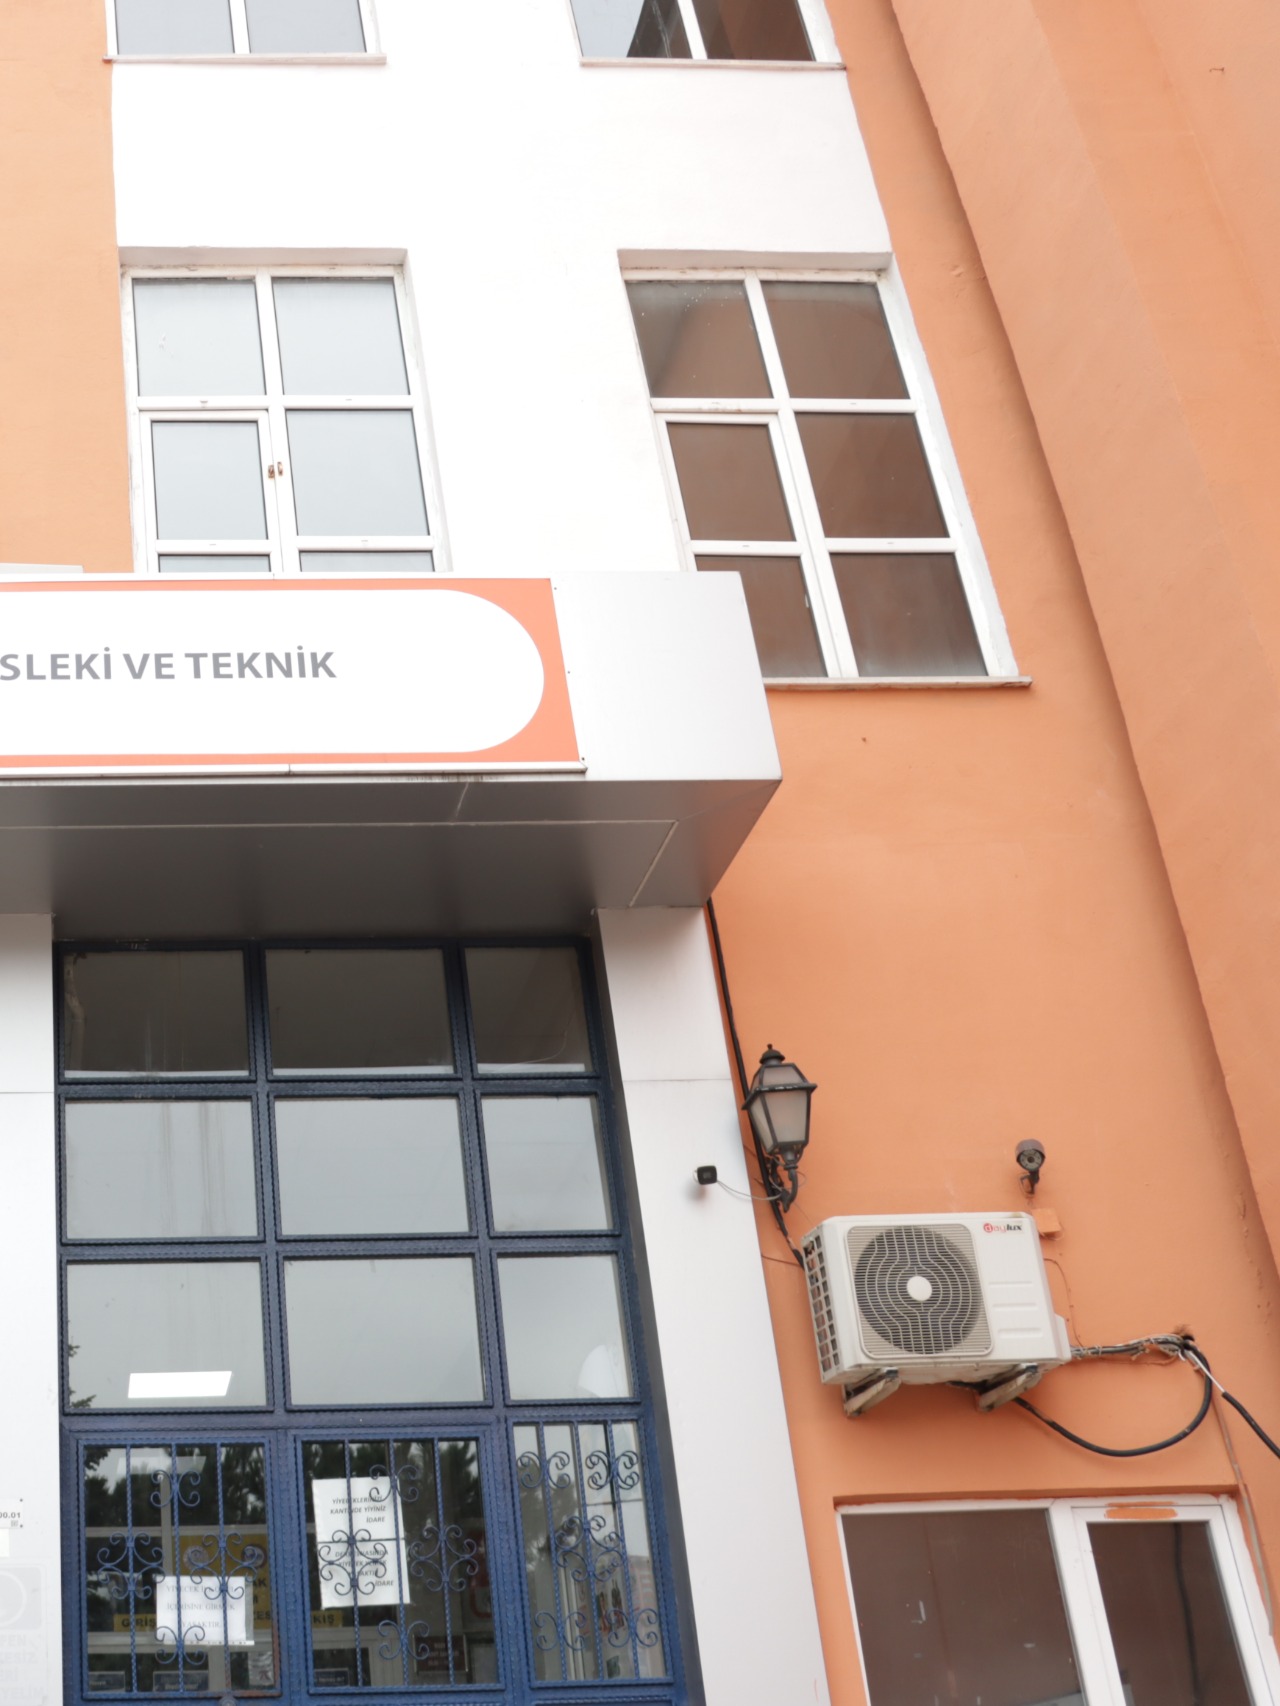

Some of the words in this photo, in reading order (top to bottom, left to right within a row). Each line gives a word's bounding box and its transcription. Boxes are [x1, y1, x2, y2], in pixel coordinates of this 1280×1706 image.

[122, 652, 176, 680] VE
[184, 644, 337, 680] TEKNİK
[330, 1506, 362, 1515] KANTNDE
[366, 1515, 386, 1524] İDARE
